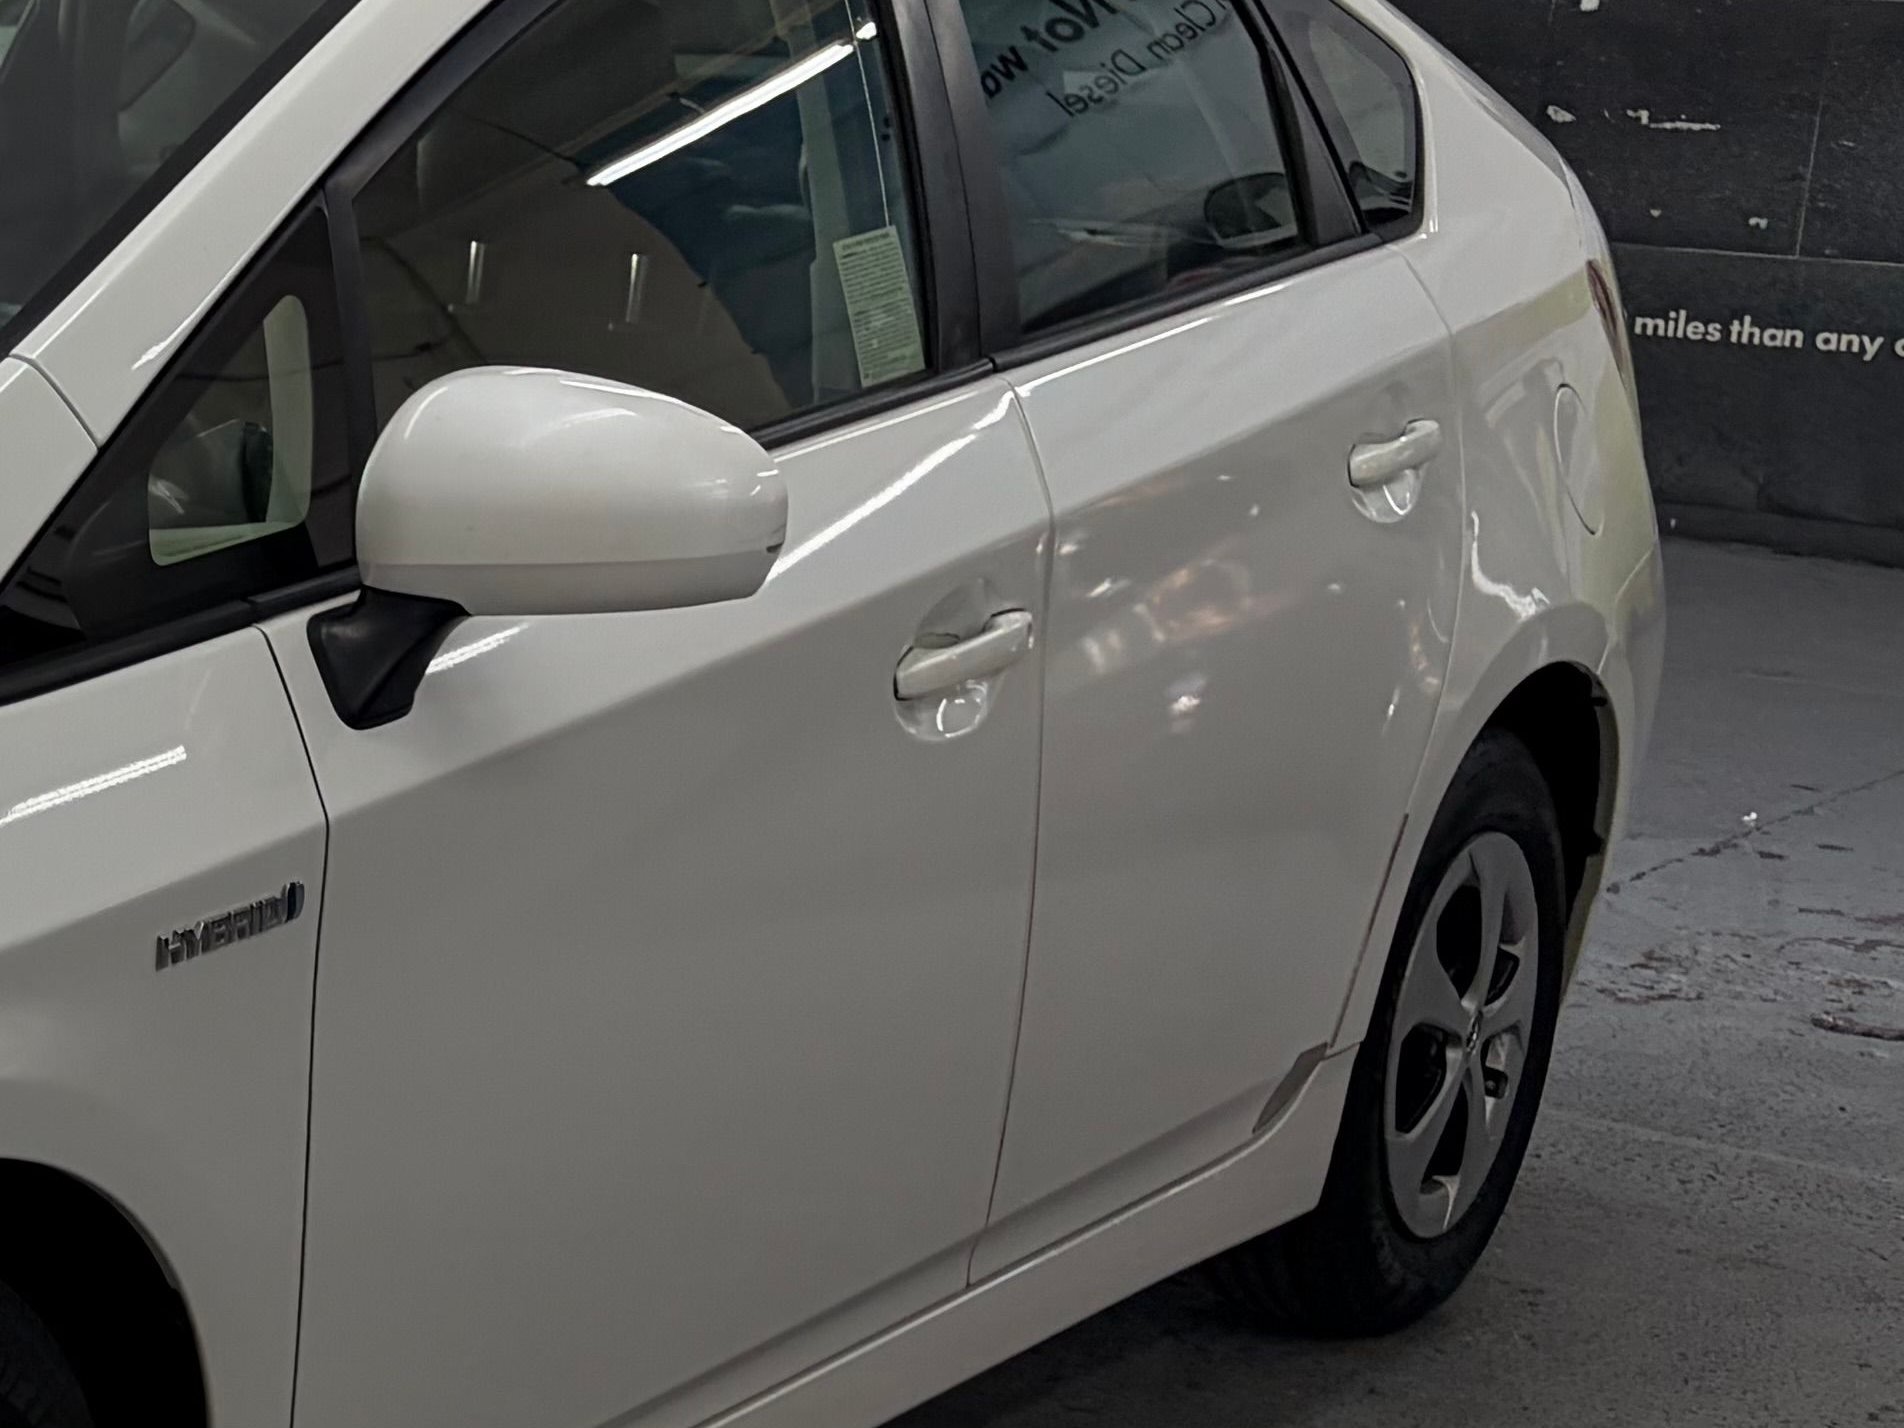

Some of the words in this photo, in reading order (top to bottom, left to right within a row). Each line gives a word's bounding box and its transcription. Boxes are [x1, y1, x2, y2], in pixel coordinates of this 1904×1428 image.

[1634, 309, 1722, 342] miles
[1729, 315, 1804, 348] than
[1815, 331, 1884, 361] any
[154, 883, 290, 972] HYBRID
